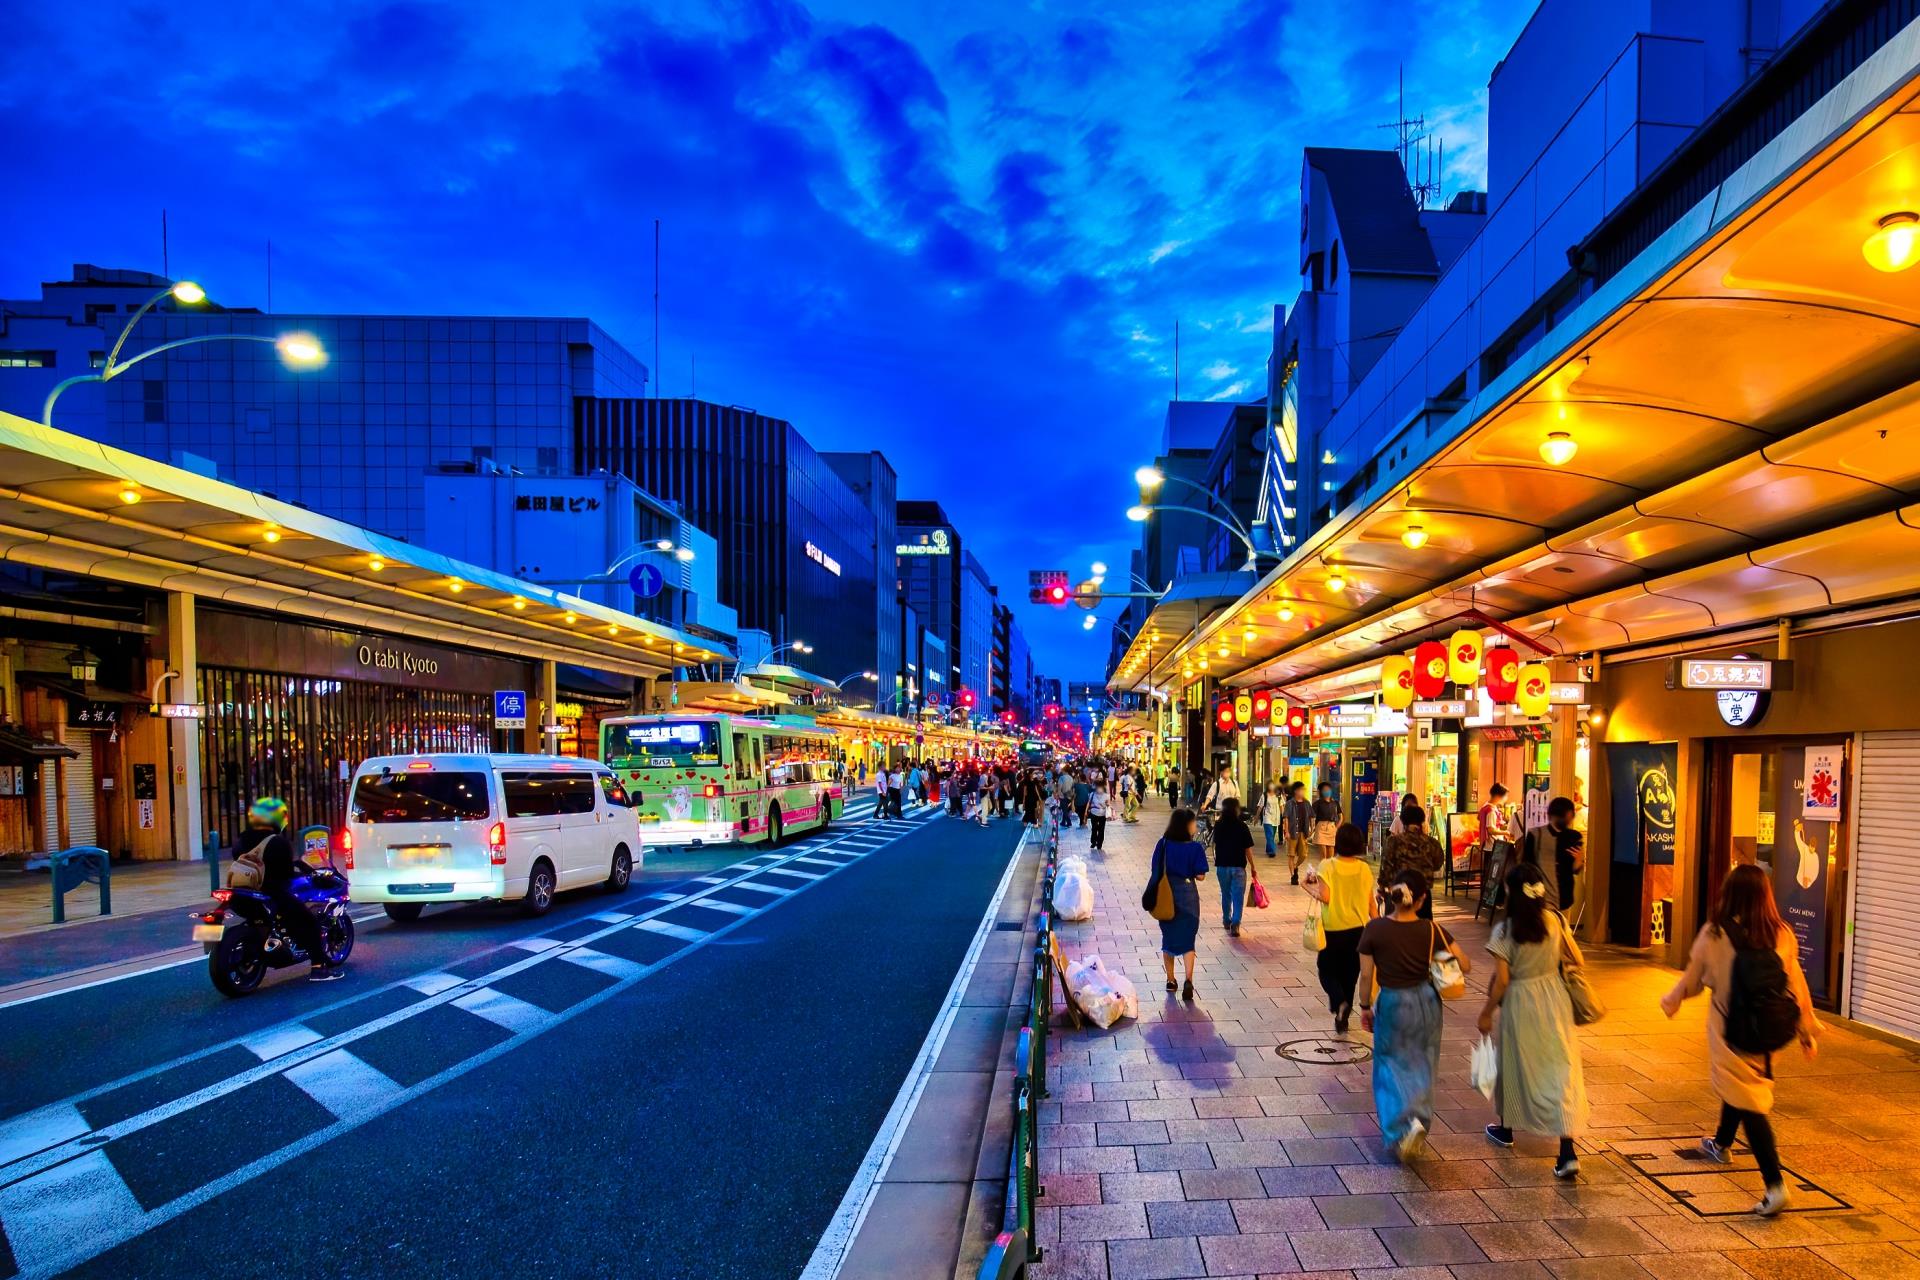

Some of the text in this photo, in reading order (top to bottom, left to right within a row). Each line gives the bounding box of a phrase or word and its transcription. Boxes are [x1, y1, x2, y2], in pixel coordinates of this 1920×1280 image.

[359, 645, 438, 676] O tabi Kyoto
[500, 695, 521, 714] 停
[1729, 703, 1743, 722] 堂
[1811, 772, 1832, 804] 氷
